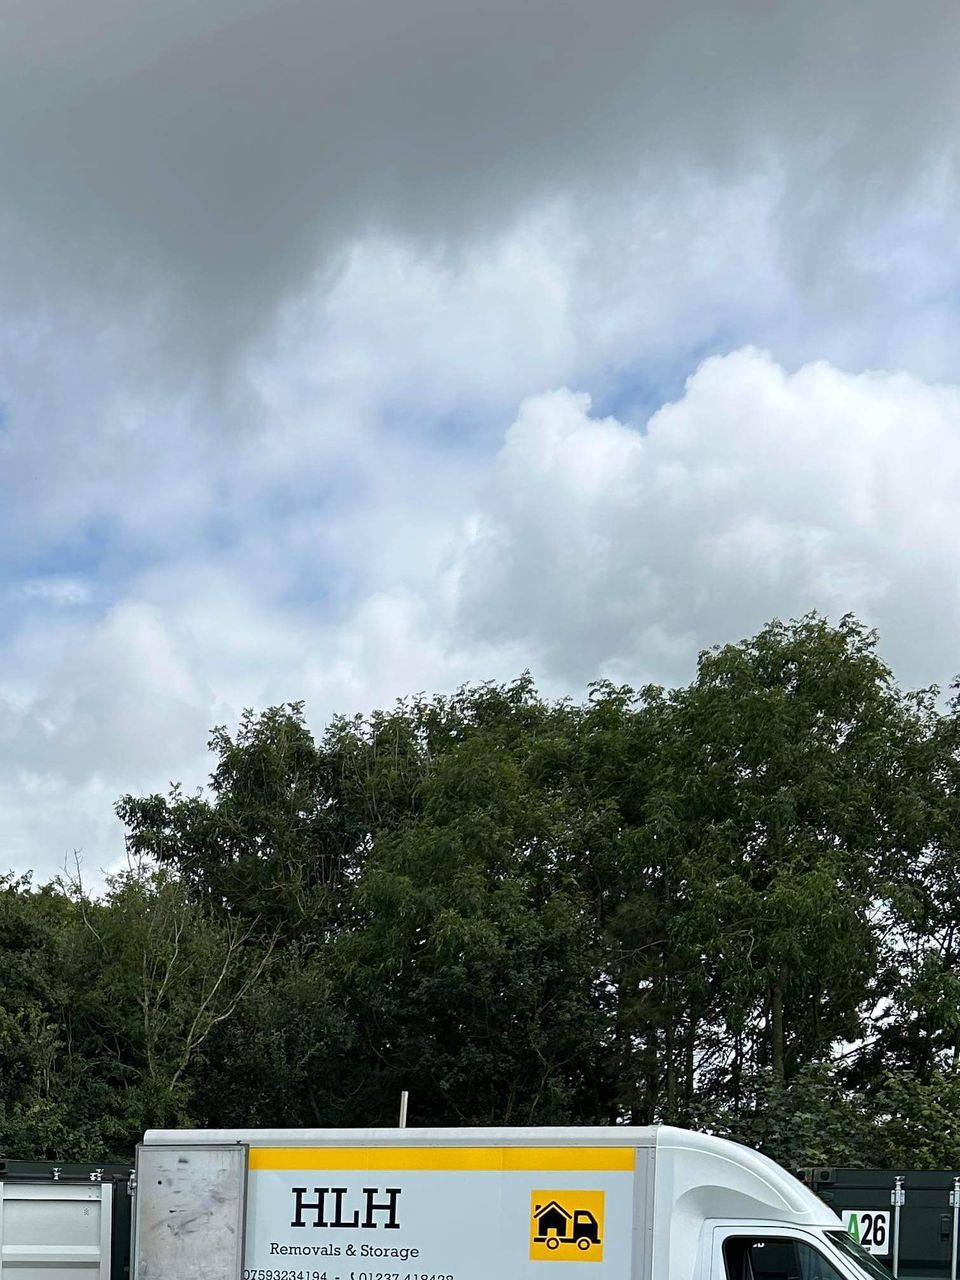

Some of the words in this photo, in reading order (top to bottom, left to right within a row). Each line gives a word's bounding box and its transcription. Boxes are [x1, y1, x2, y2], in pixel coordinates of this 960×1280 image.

[290, 1187, 402, 1229] HLH
[846, 1213, 886, 1246] A26
[270, 1243, 341, 1257] Removals
[345, 1244, 357, 1257] &
[360, 1244, 420, 1261] Storage
